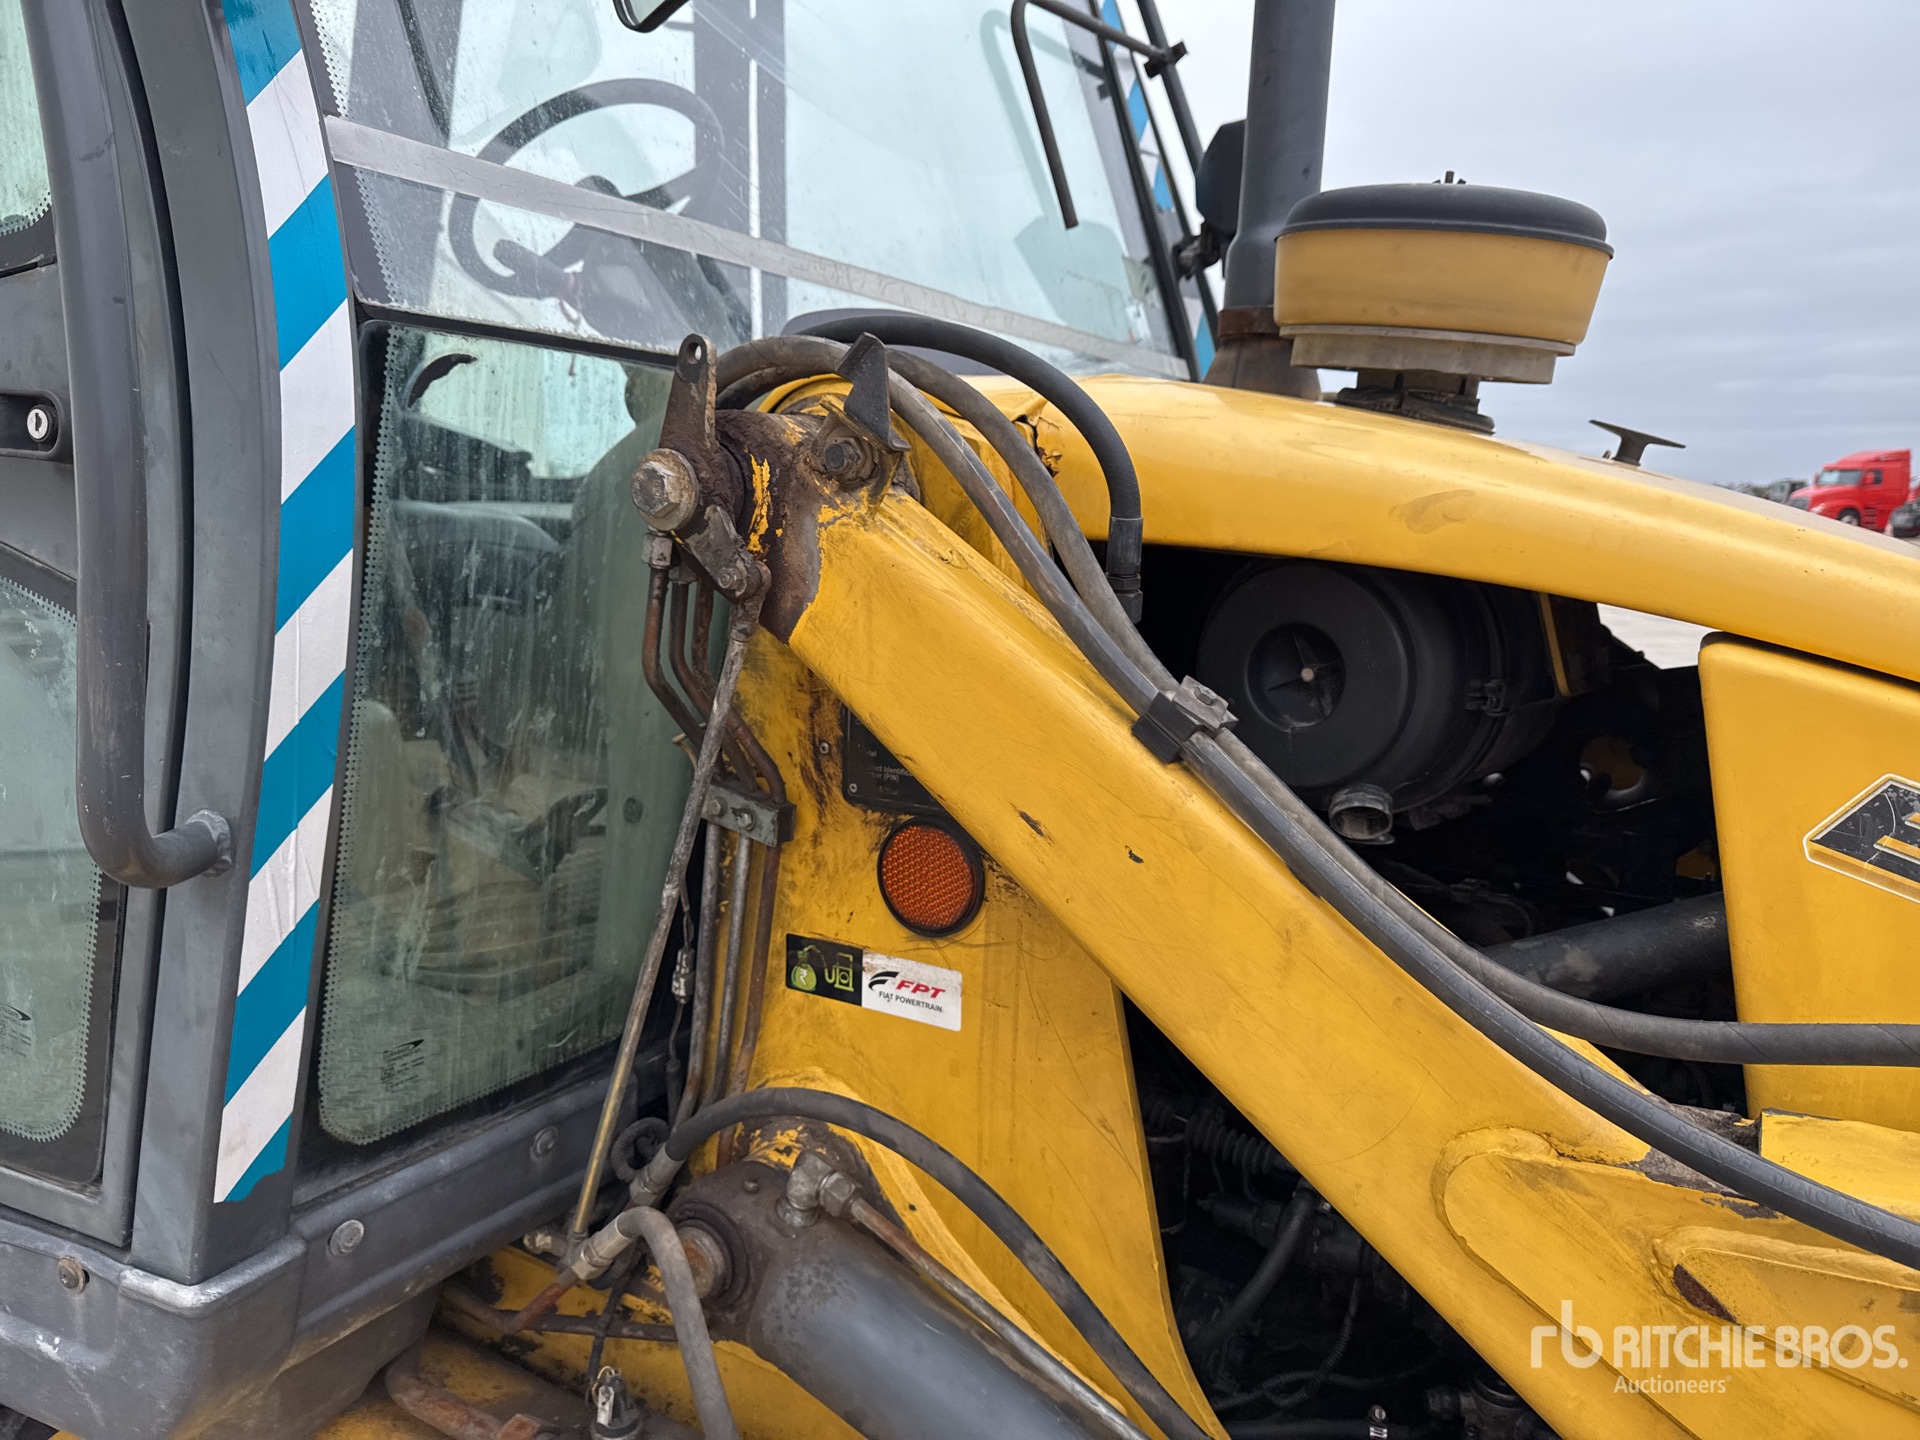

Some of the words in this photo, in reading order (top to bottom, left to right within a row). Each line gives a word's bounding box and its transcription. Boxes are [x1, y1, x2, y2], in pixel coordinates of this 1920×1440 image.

[895, 979, 946, 999] FPT
[879, 990, 893, 1001] FIAT
[895, 994, 943, 1013] POWERTRAIN
